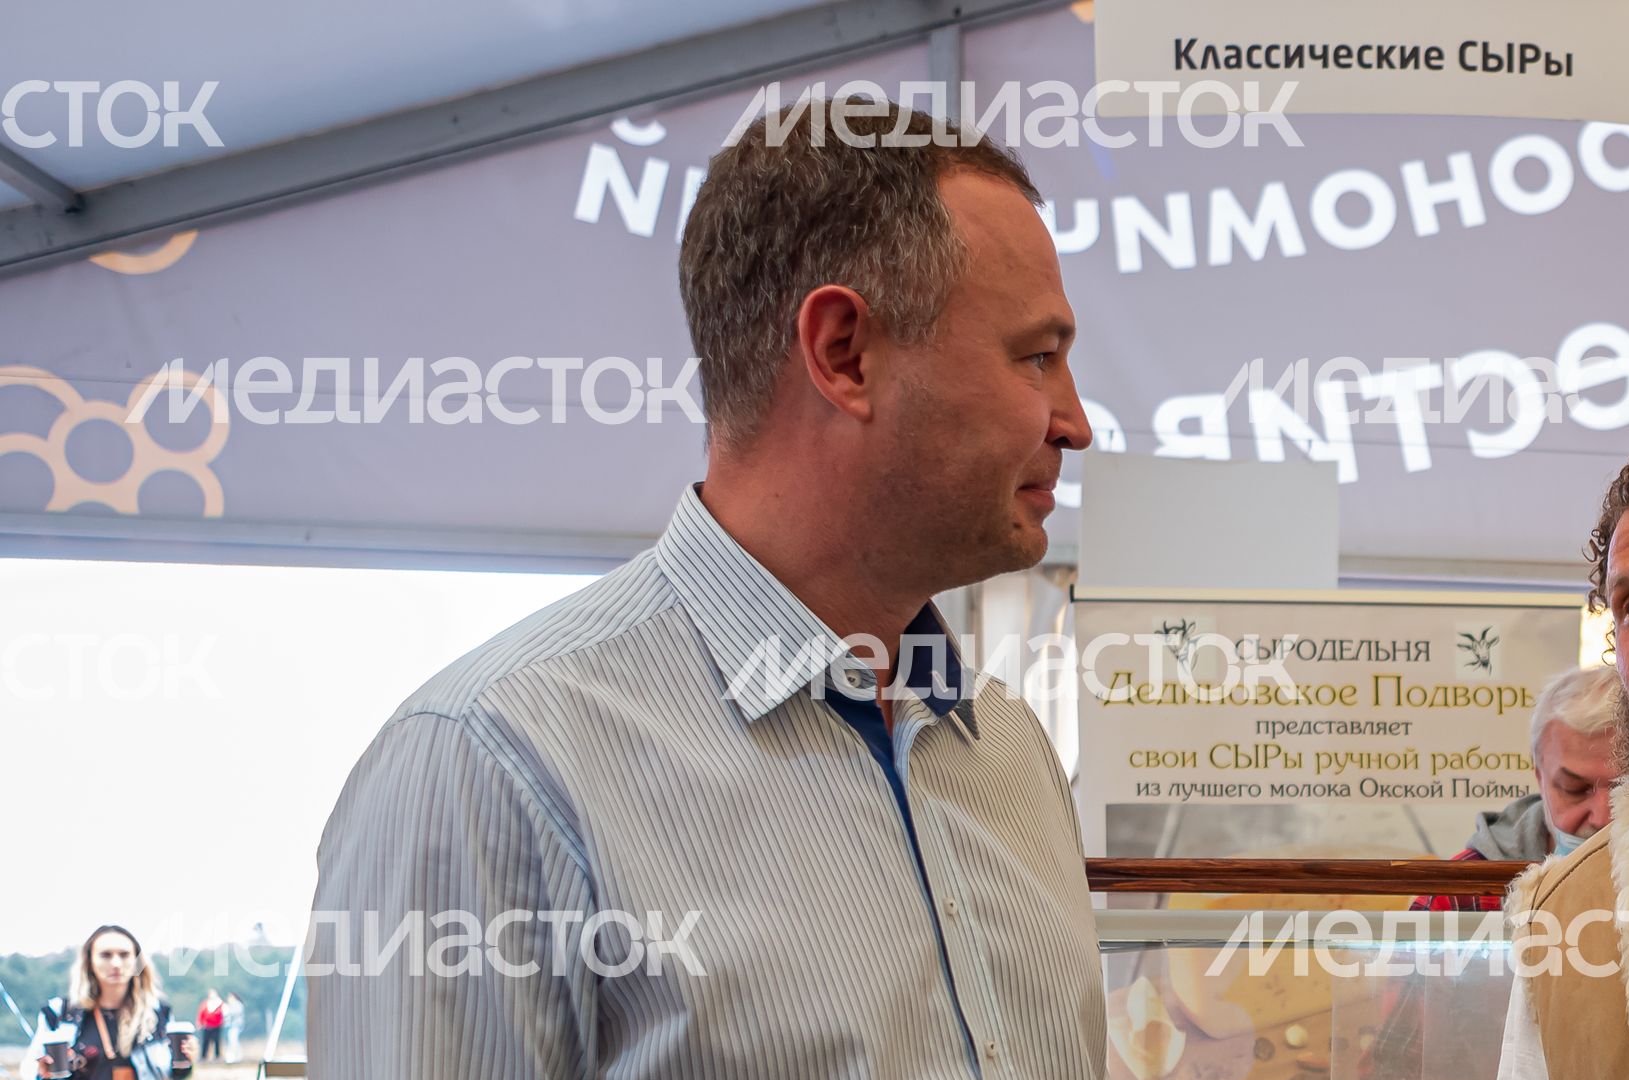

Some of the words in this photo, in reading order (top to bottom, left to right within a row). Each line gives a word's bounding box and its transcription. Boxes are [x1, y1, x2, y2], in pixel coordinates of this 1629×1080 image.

[1173, 37, 1446, 71] Классические
[1457, 40, 1574, 77] СЫРы
[1234, 638, 1431, 663] СЫРОДЕЛЬНЯ
[1372, 674, 1537, 715] Подворь
[1256, 718, 1413, 739] представляет
[1129, 750, 1198, 768] свои
[1209, 742, 1302, 770] СЫРы
[1315, 747, 1419, 775] ручной
[1431, 745, 1534, 776] работы
[1136, 782, 1161, 797] из
[1168, 782, 1262, 801] лучшего
[1270, 783, 1350, 798] молока
[1359, 777, 1443, 798] Окской
[1452, 778, 1530, 799] Поймы
